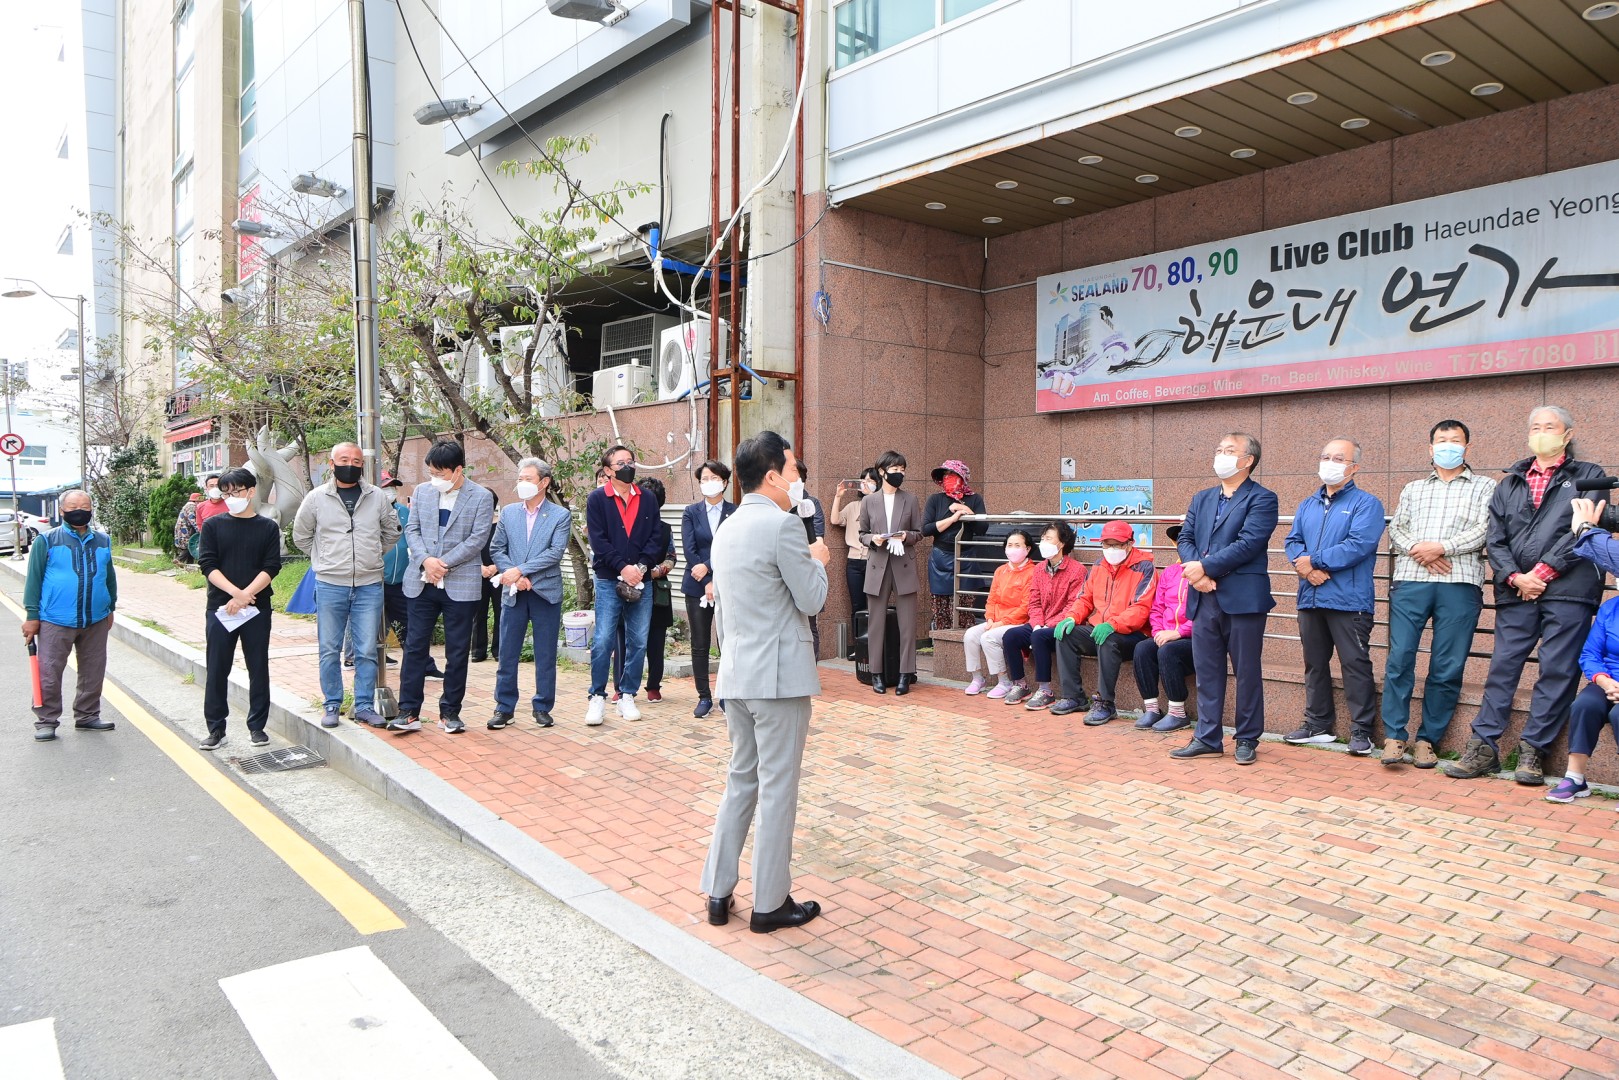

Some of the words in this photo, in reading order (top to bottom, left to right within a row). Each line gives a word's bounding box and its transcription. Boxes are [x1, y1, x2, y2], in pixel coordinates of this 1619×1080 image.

[1270, 241, 1329, 272] Live
[1337, 222, 1414, 261] Club
[1424, 207, 1540, 242] Haeundae
[1208, 247, 1238, 276] 90
[1071, 277, 1129, 302] SEALAND
[1178, 279, 1357, 363] 해운대
[1381, 243, 1619, 332] 연가
[1213, 379, 1243, 392] Wine
[1395, 359, 1433, 374] Wine
